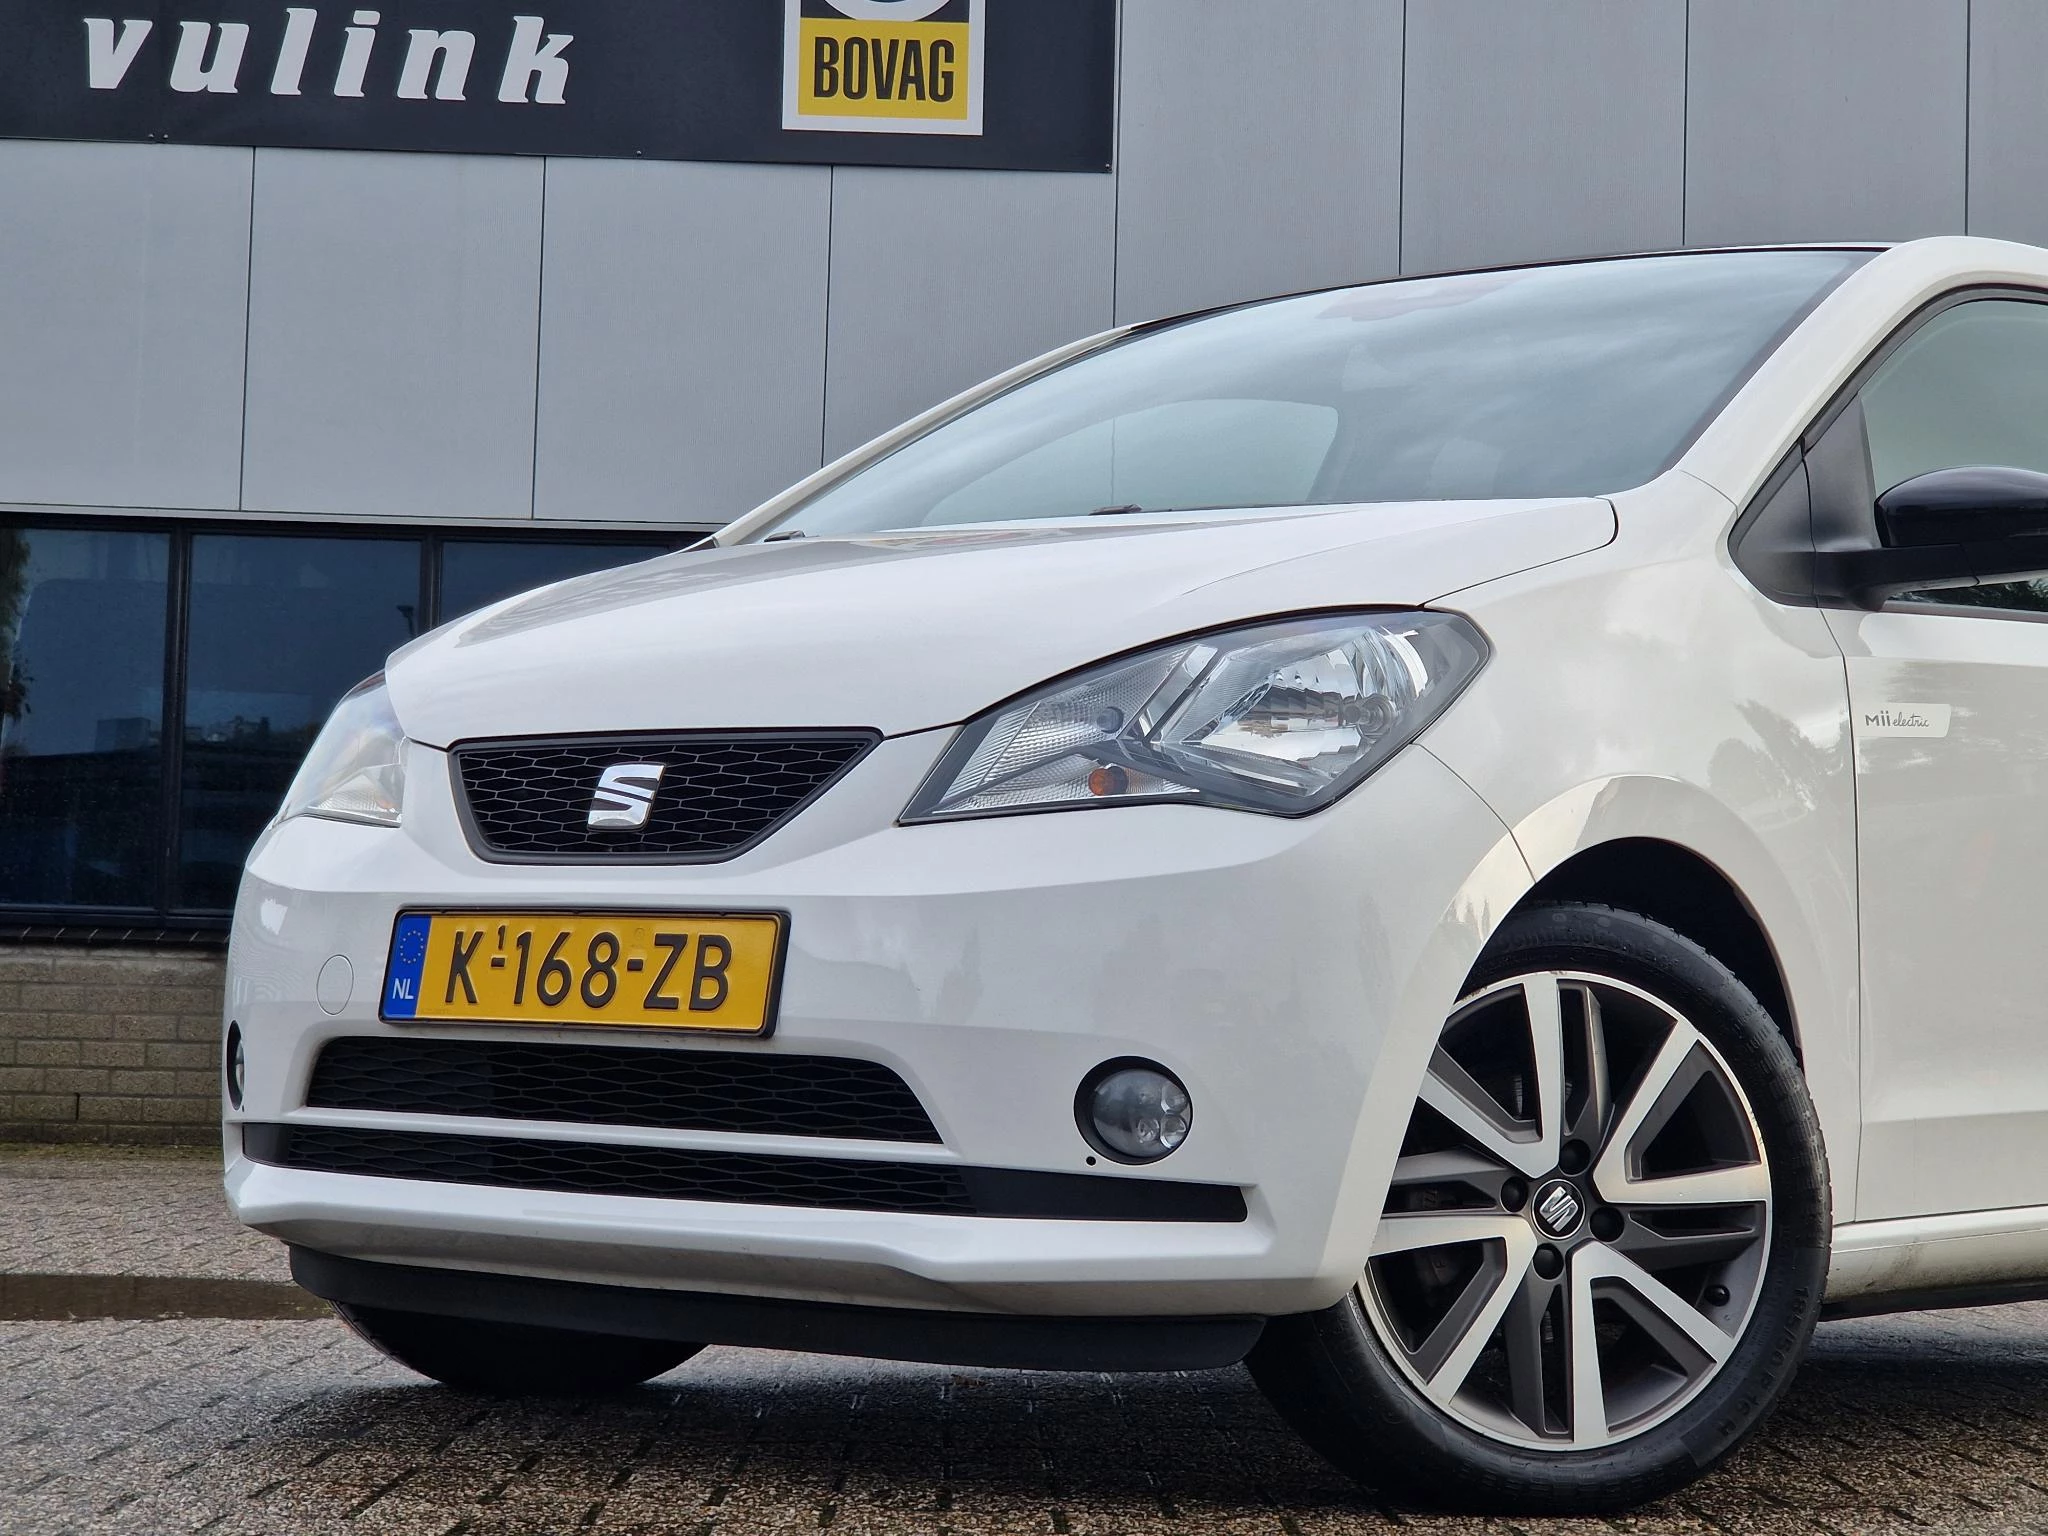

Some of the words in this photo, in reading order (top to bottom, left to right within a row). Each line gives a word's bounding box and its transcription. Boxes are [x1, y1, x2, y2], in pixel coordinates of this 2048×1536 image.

[84, 8, 574, 104] vulink
[813, 36, 955, 103] BOVAG
[1865, 710, 1891, 727] Mii
[1892, 711, 1930, 727] electric
[392, 978, 414, 1000] NL
